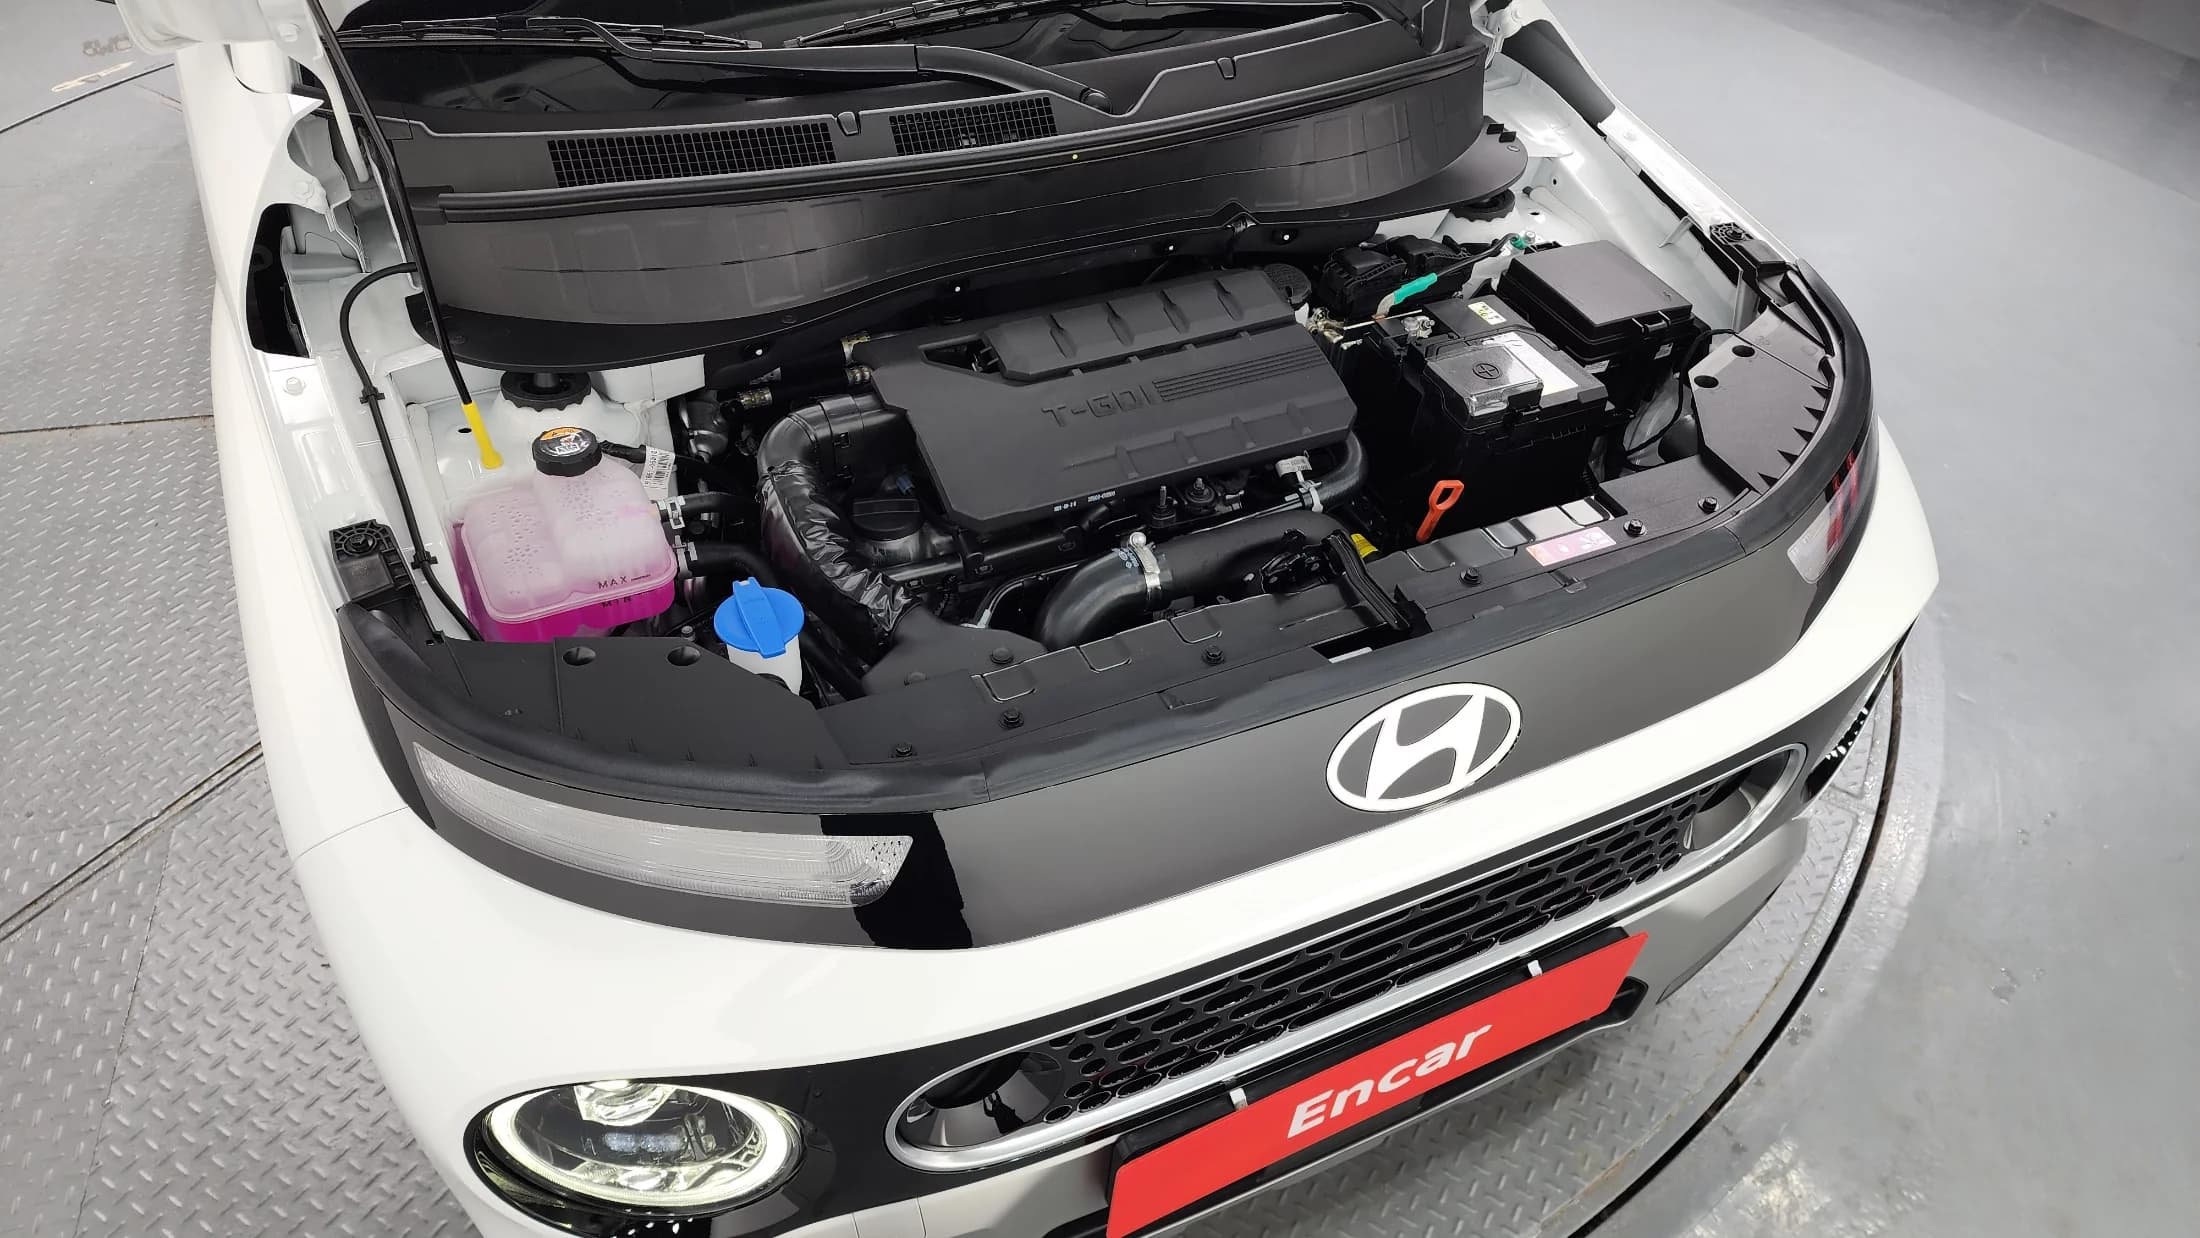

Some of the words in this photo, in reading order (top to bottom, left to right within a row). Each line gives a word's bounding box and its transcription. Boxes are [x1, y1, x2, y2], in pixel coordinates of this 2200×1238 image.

[1041, 384, 1151, 427] T-GDI
[597, 575, 628, 590] MAX
[1287, 1024, 1493, 1139] Encar
